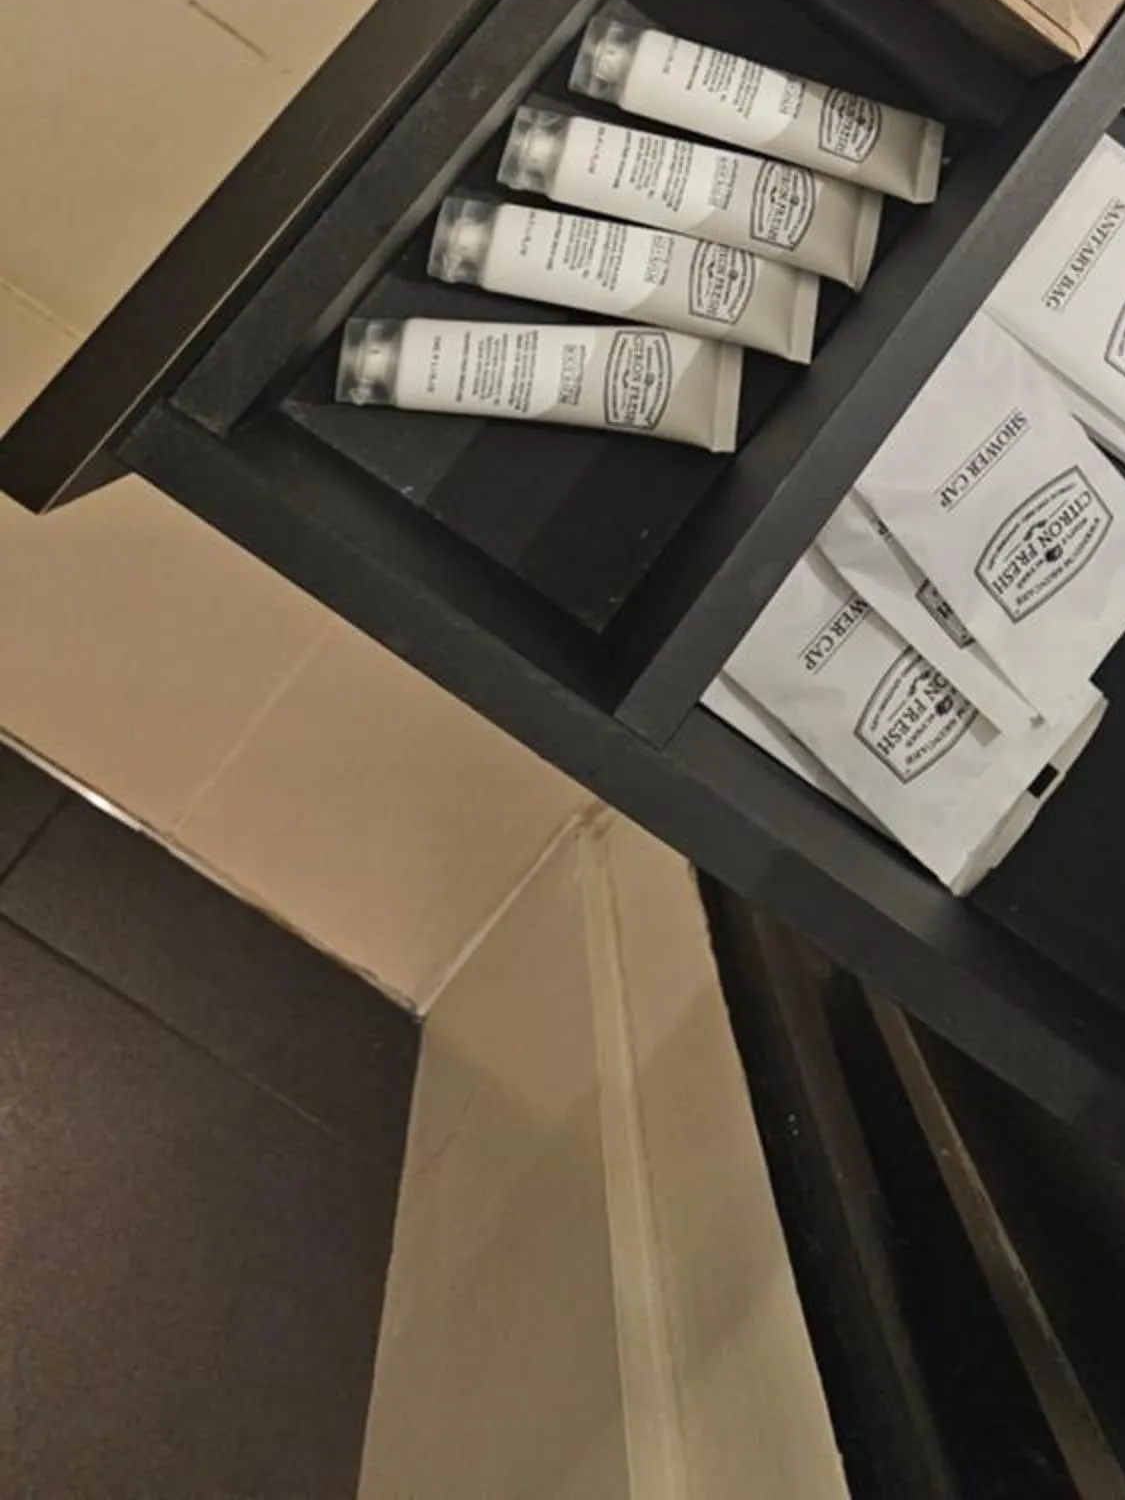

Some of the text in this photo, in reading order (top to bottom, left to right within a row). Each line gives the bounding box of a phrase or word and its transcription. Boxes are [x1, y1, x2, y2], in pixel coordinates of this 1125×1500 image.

[1043, 273, 1076, 312] BAG
[935, 411, 1029, 508] SHOWER CAP
[1035, 489, 1094, 549] CITRON
[990, 542, 1039, 595] FRESH
[800, 594, 869, 671] WER CAP
[875, 697, 927, 755] FRESH
